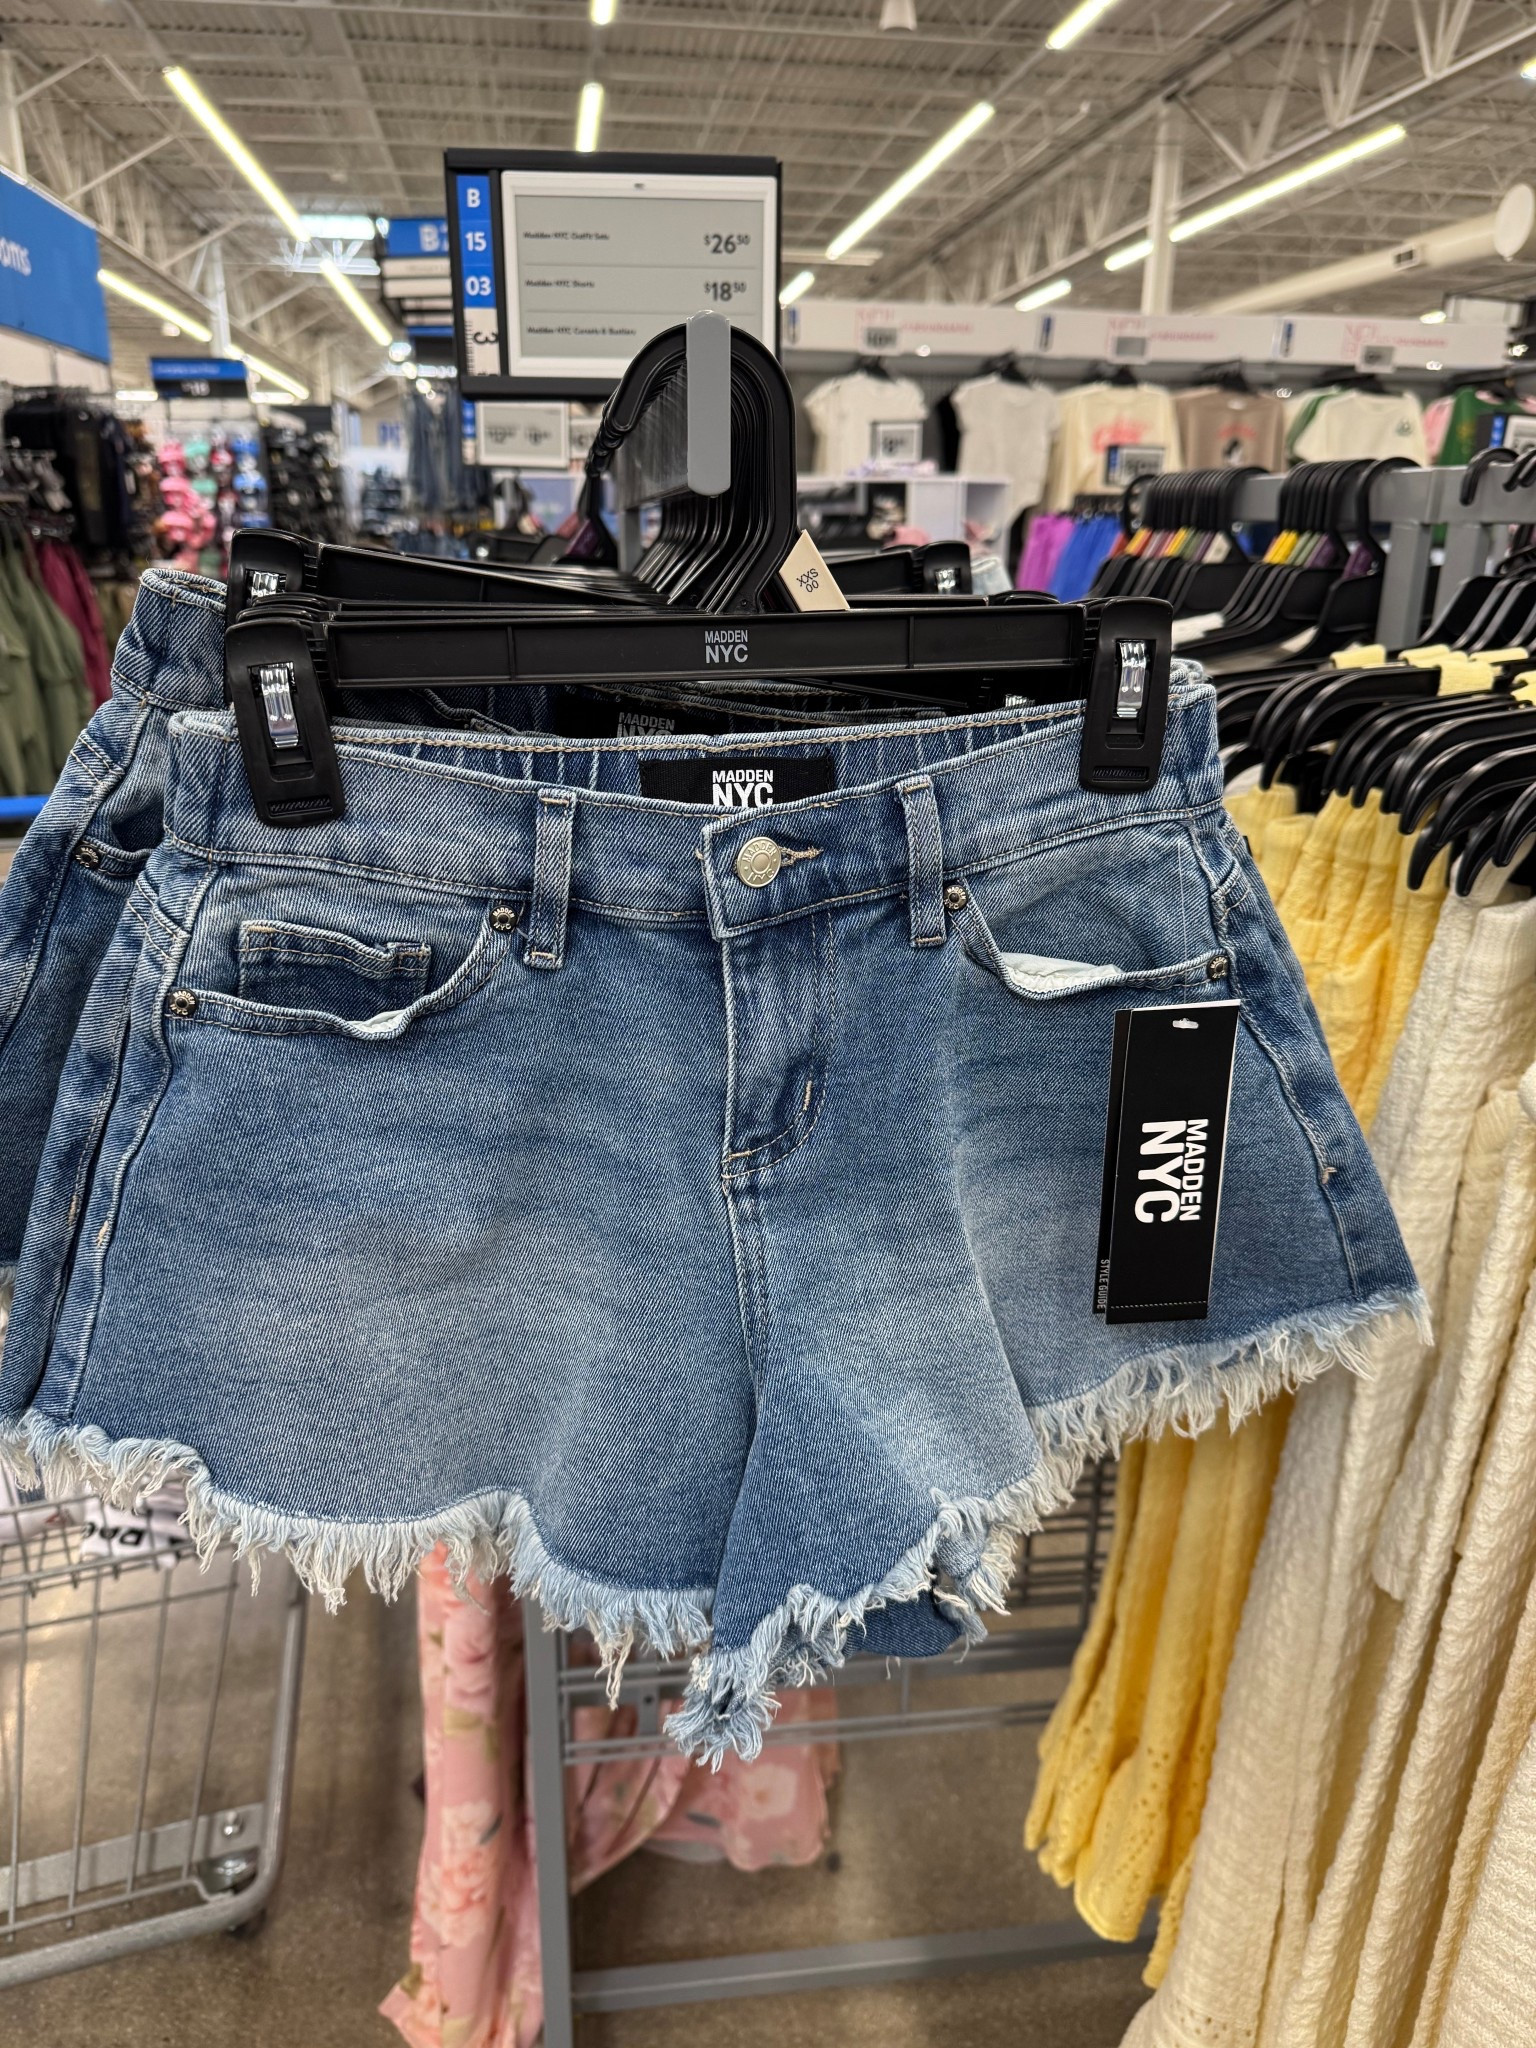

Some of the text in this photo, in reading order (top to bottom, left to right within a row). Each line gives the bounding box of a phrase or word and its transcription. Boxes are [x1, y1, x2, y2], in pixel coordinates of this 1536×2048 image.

[466, 187, 482, 208] B
[465, 231, 488, 251] 15
[465, 275, 492, 296] 03
[796, 568, 819, 587] XXS
[805, 580, 819, 593] 00
[704, 629, 748, 644] MADDEN
[705, 644, 748, 664] NYC
[618, 712, 675, 731] MADDEN
[712, 769, 774, 783] MADDEN
[712, 782, 774, 808] NYC
[1134, 1120, 1187, 1224] NYC
[1179, 1118, 1209, 1222] MADDEN
[1096, 1258, 1110, 1310] STYLE GUIDE
